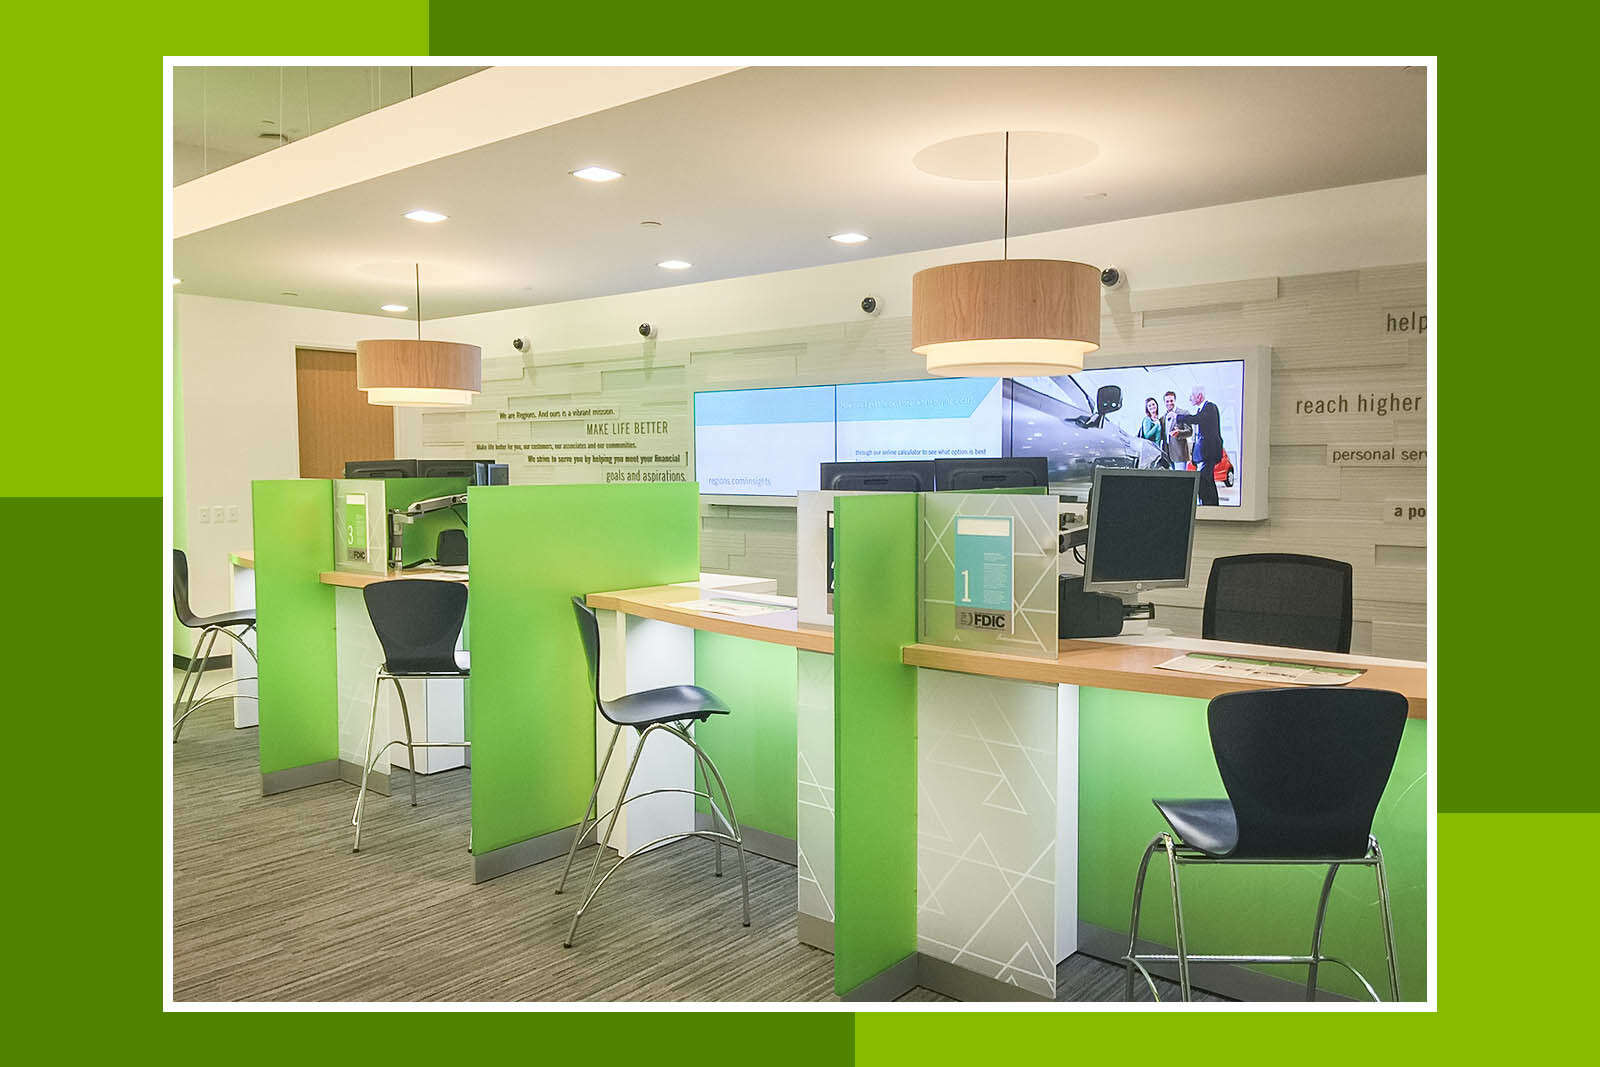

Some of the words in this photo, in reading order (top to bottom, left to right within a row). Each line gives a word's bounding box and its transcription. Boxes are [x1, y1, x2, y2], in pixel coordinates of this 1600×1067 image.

[1296, 395, 1348, 414] reach
[1358, 392, 1422, 416] higher
[516, 411, 537, 420] Regions.
[538, 410, 548, 418] And
[573, 408, 591, 416] vibrant
[592, 408, 615, 416] mission.
[586, 423, 609, 435] MAKE
[612, 422, 631, 435] LIFE
[634, 421, 668, 434] BETTER
[605, 441, 637, 449] communities.
[938, 447, 950, 455] what
[951, 447, 968, 456] option
[969, 447, 974, 455] is
[975, 447, 986, 455] best
[584, 455, 591, 464] by
[592, 454, 612, 464] helping
[625, 455, 638, 463] meet
[655, 454, 680, 462] financial
[1332, 448, 1395, 463] personal
[606, 469, 625, 483] goals
[627, 469, 640, 482] and
[642, 469, 687, 483] aspirations.
[1394, 506, 1403, 518] a
[1409, 507, 1426, 520] po
[347, 525, 354, 545] 3
[961, 570, 972, 603] 1
[974, 614, 1005, 628] FDIC
